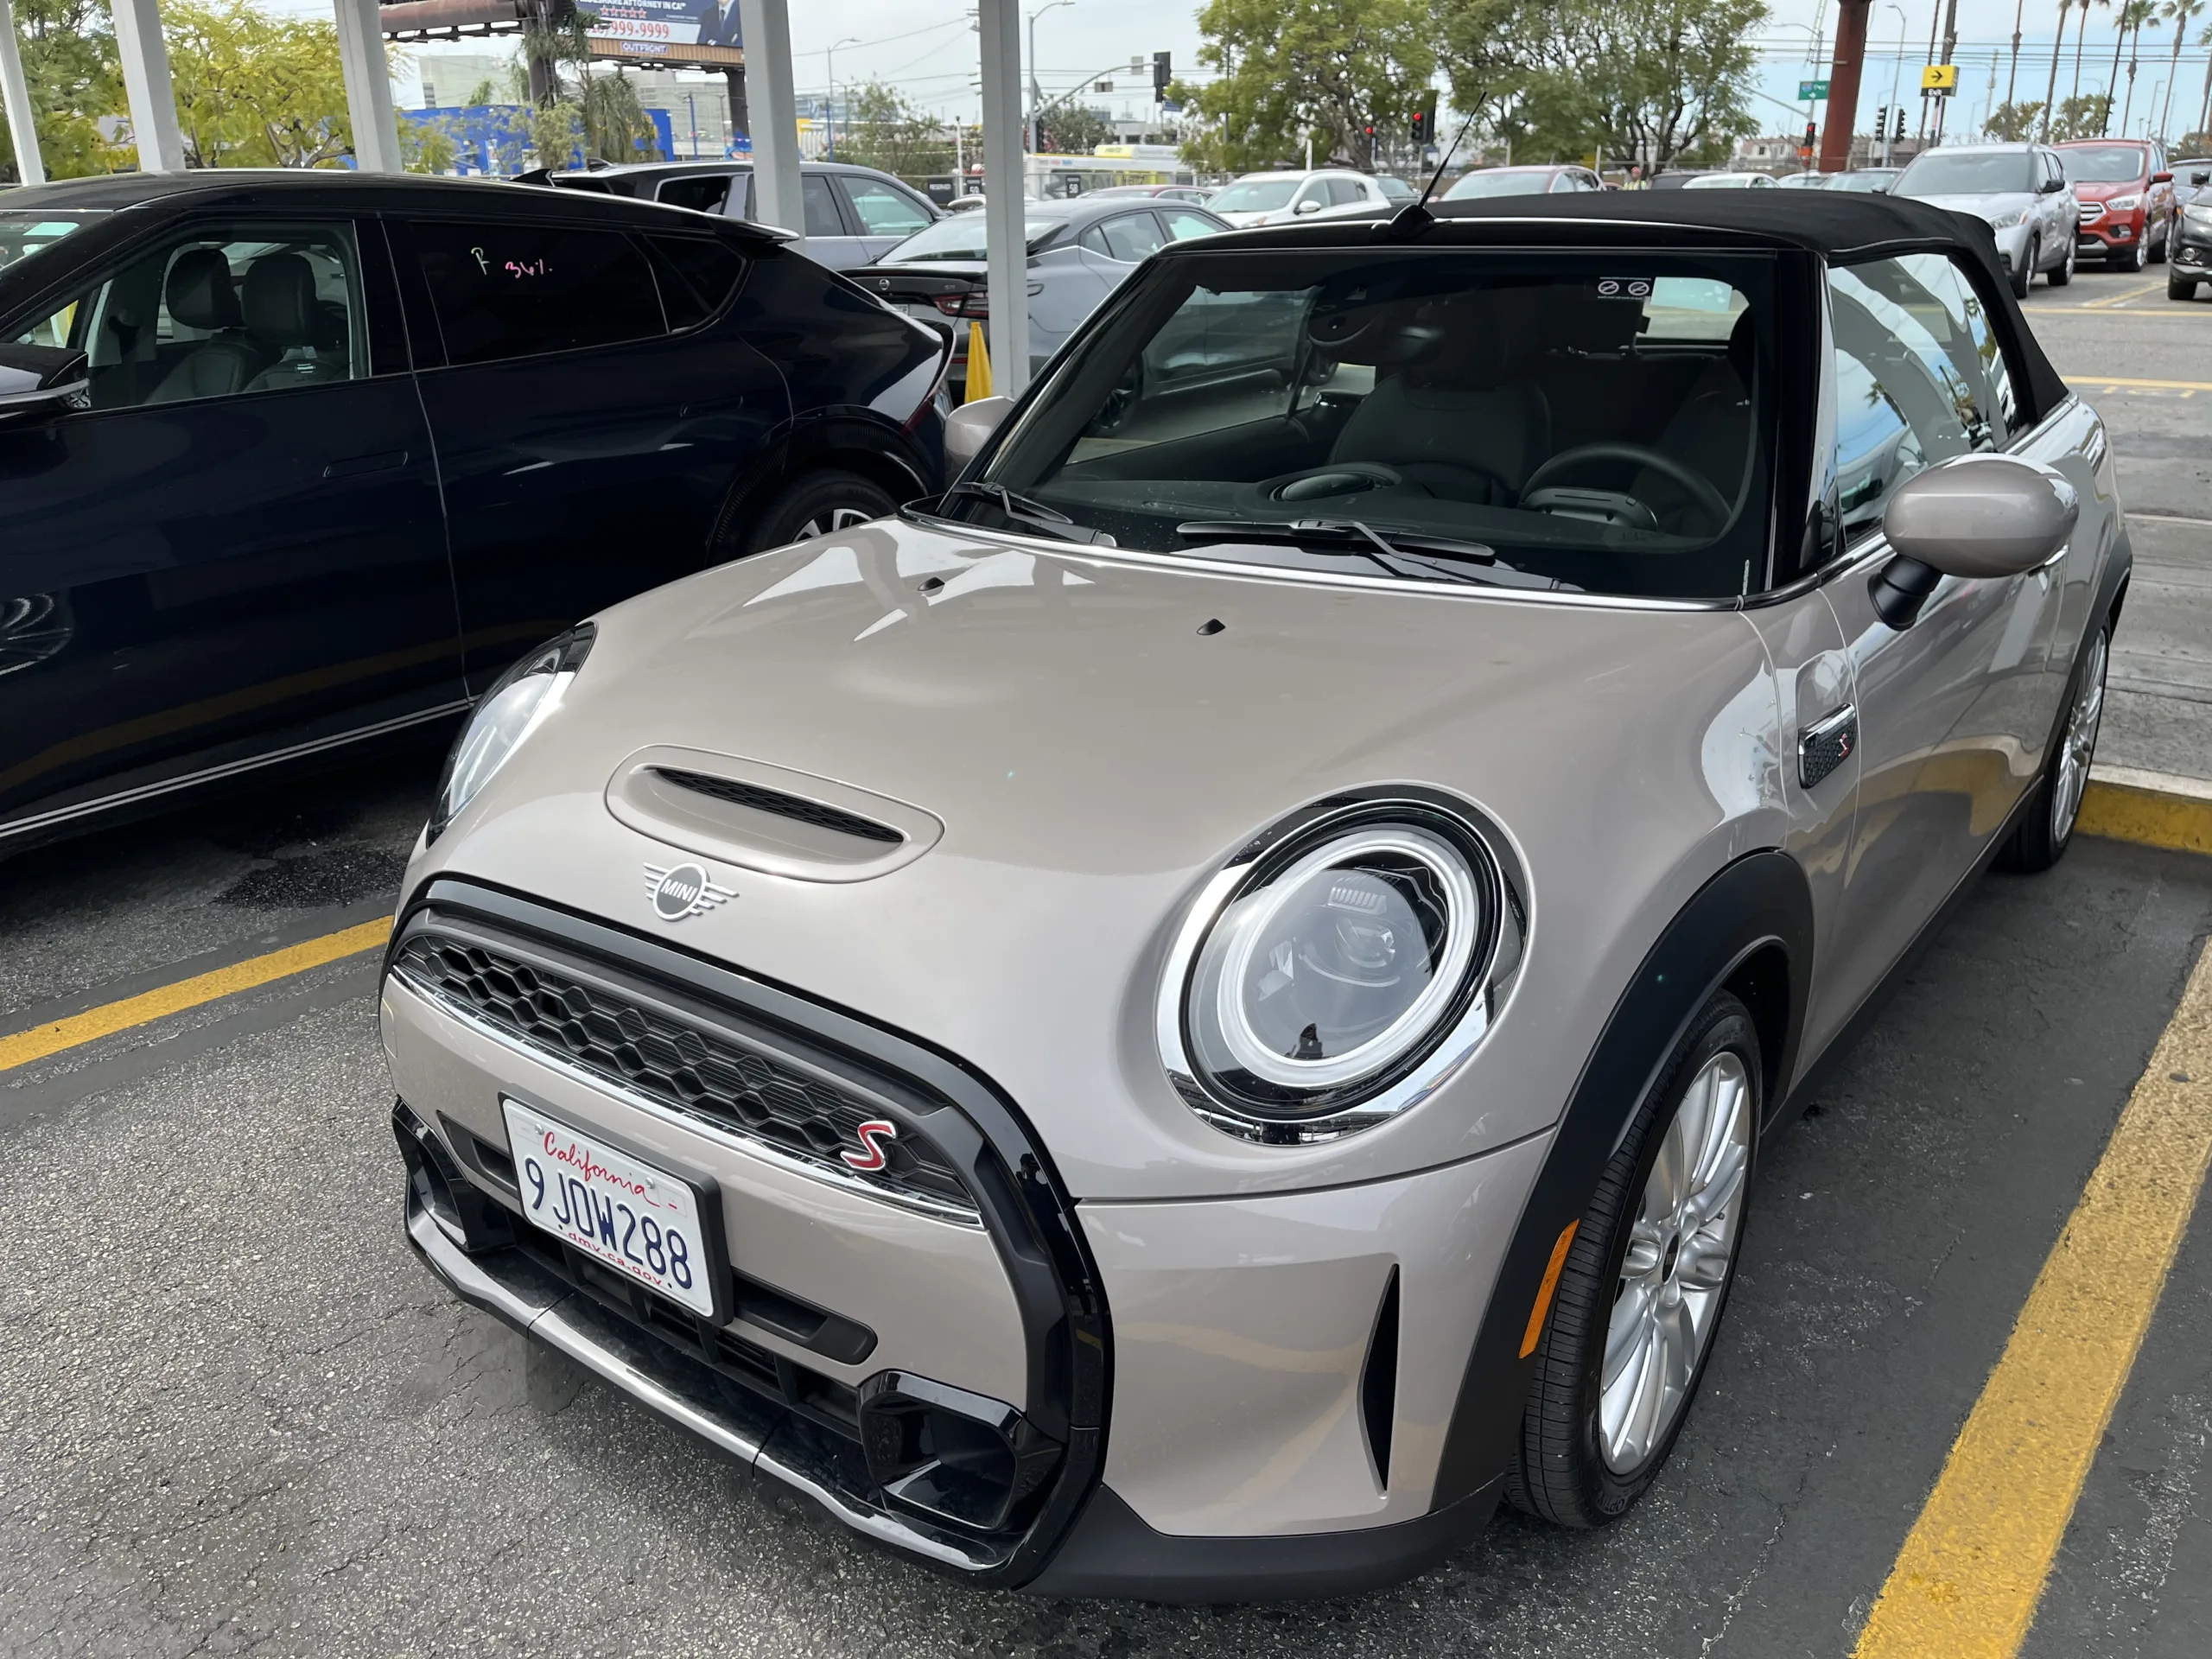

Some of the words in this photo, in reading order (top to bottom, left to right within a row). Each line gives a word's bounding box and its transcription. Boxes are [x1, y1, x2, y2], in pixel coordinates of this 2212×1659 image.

[622, 41, 667, 53] OUTFRONT
[660, 879, 698, 902] MINI
[543, 1131, 661, 1208] California
[840, 1120, 897, 1171] S
[567, 1231, 663, 1286] dmv.ca.gov
